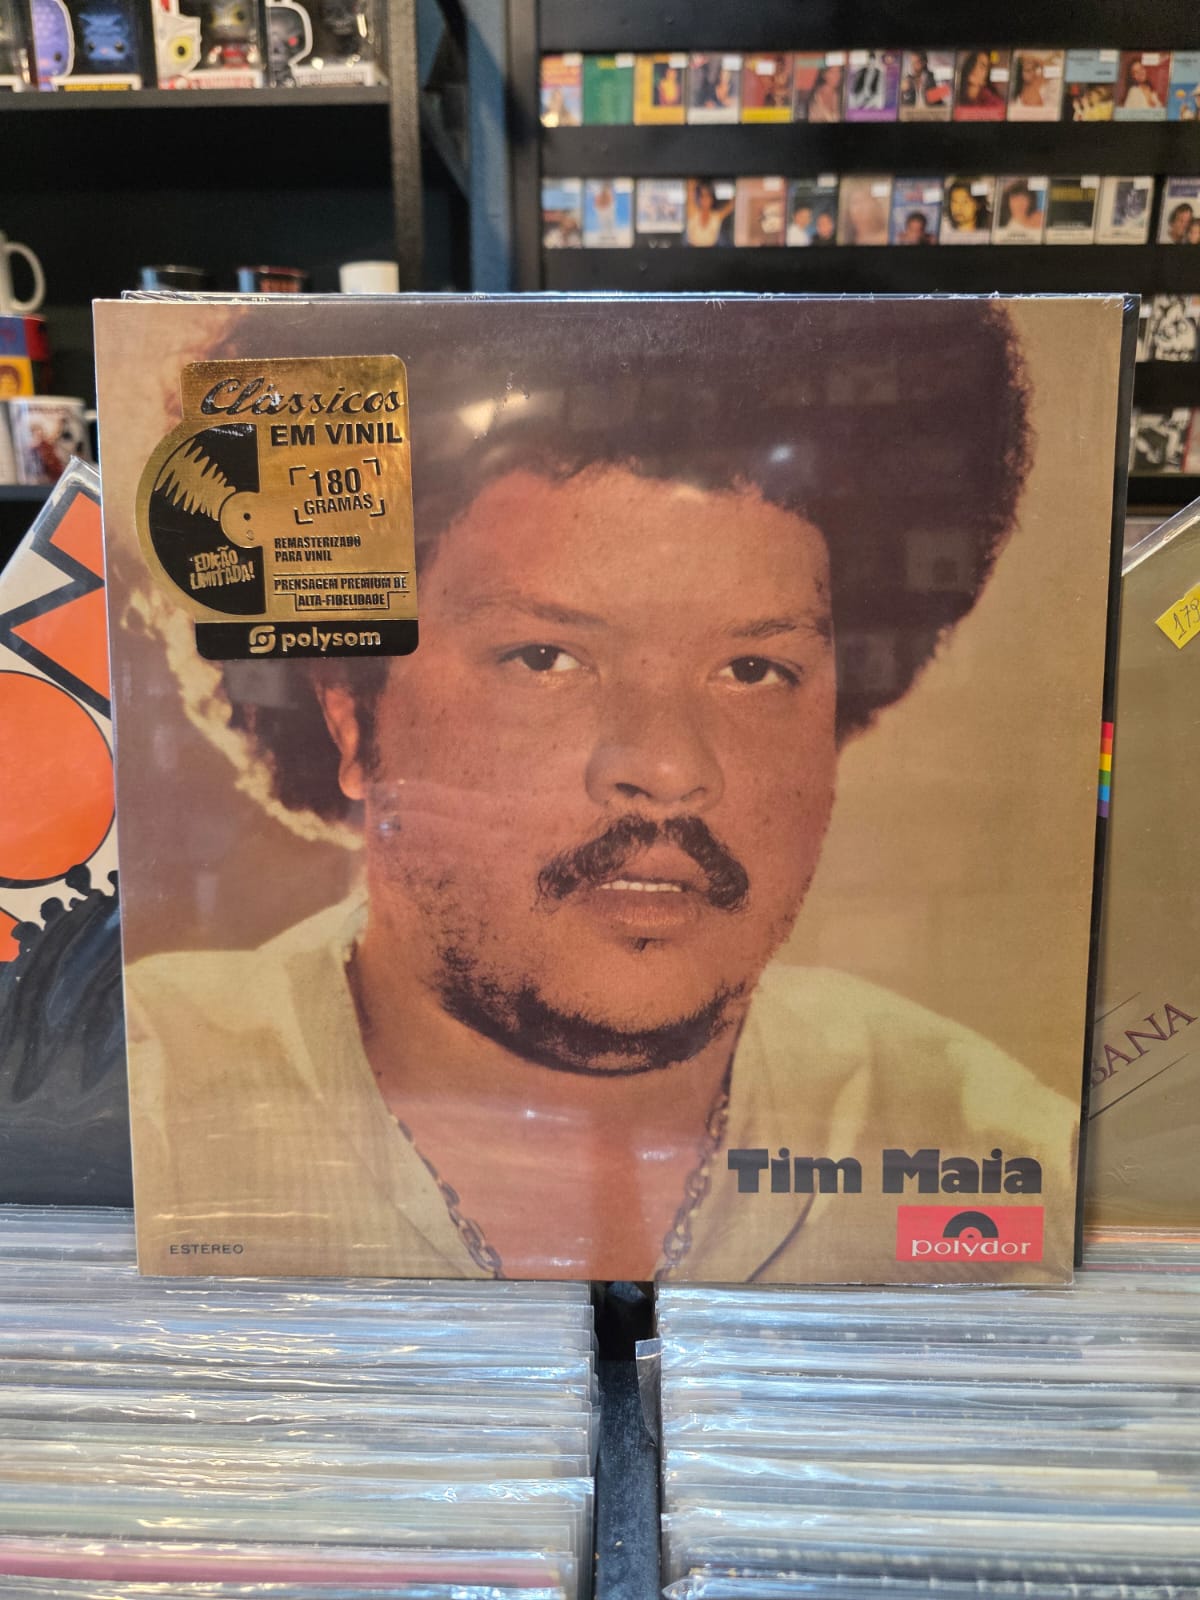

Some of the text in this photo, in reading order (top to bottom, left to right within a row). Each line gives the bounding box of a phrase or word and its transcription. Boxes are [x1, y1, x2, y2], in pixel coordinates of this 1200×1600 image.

[201, 377, 403, 415] Clássicos
[271, 422, 403, 446] EM VINIL
[309, 467, 362, 497] 180
[304, 494, 374, 516] GRAMAS
[274, 536, 361, 549] REMASTERIZADO
[275, 549, 332, 562] PARA VINIL
[274, 577, 407, 591] PRENSAGEM PREMIUM DE
[298, 594, 386, 606] ALTA-FIDELIDADE
[281, 626, 381, 652] polysom
[728, 1147, 1042, 1194] Tim Maia
[911, 1238, 1031, 1257] polydor
